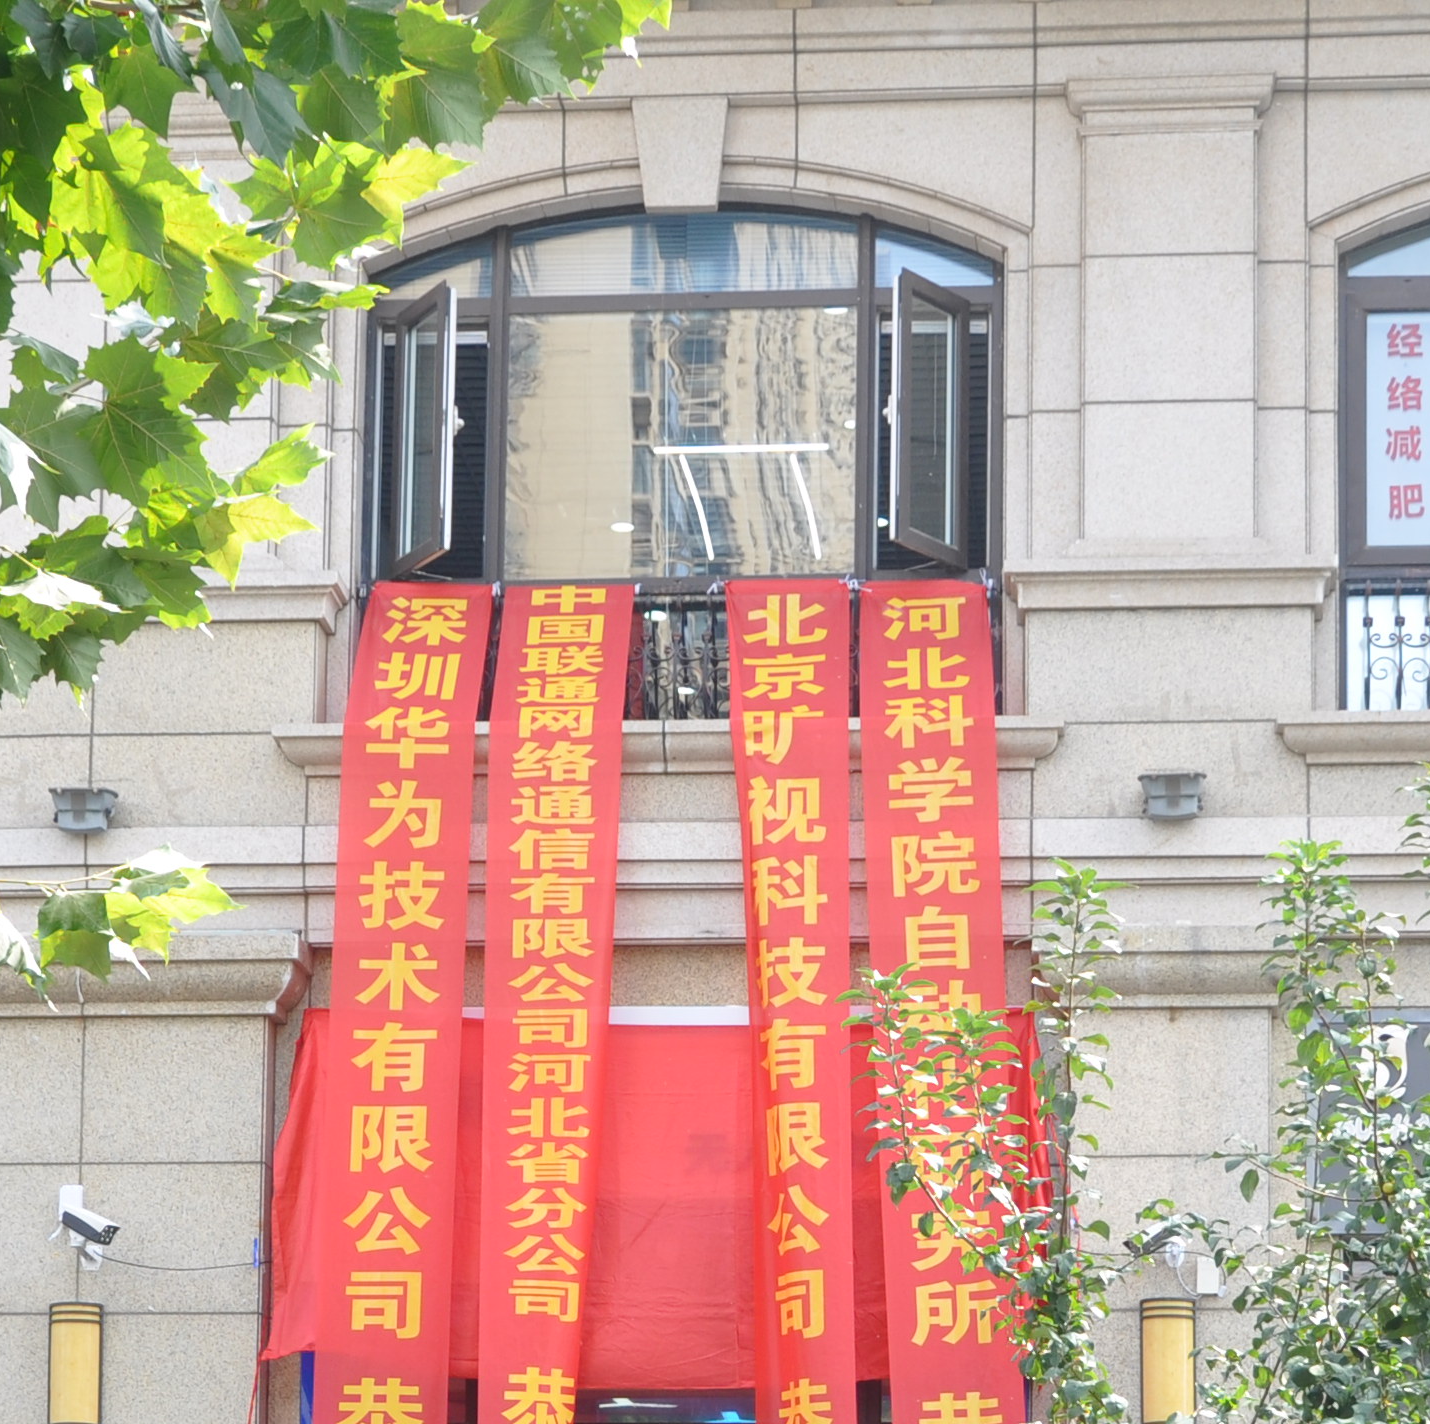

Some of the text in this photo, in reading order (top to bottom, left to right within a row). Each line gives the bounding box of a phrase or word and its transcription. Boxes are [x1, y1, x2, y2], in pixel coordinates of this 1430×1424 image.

[1386, 323, 1425, 520] 经络减肥
[343, 596, 468, 1339] 深圳华为技术有限公司
[505, 586, 607, 1323] 中国联通网络通信有限公司河北省分公司
[742, 594, 829, 1339] 北京旷视科技有限公司
